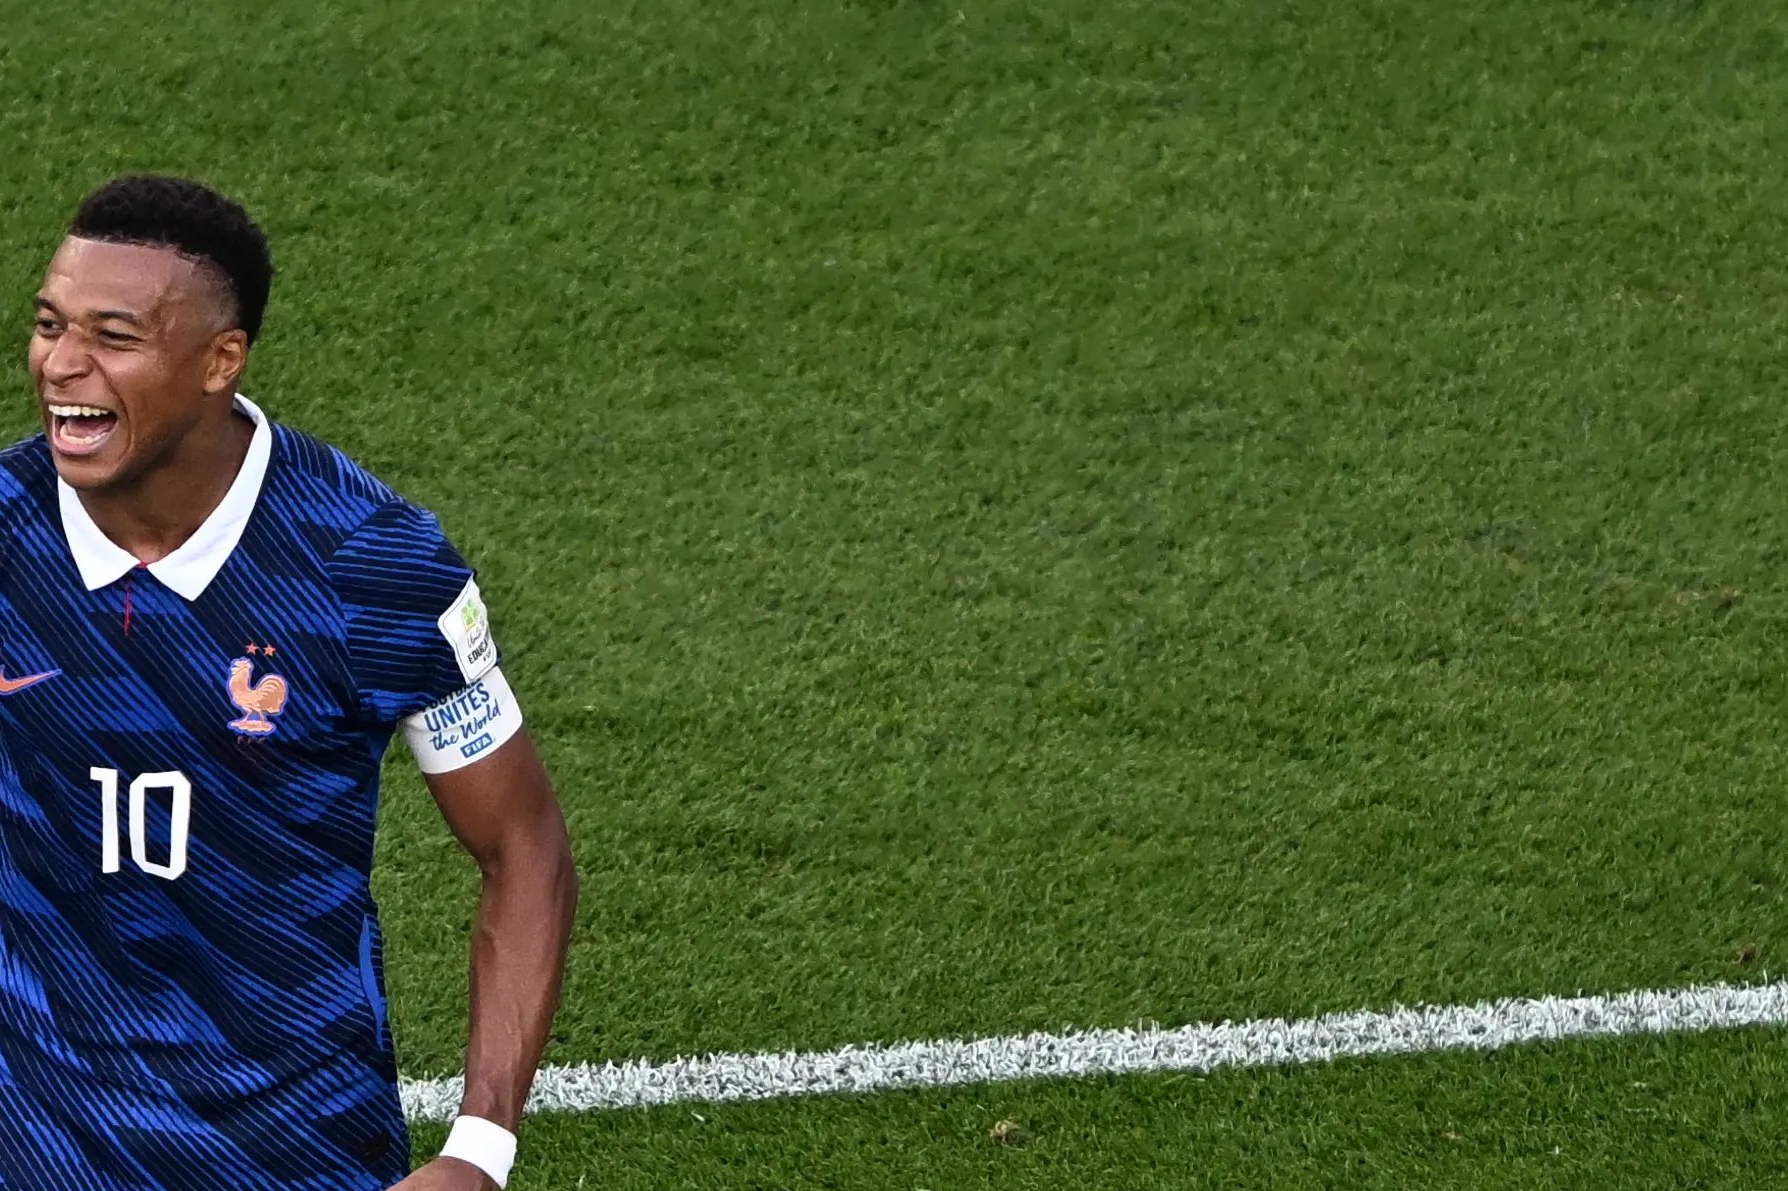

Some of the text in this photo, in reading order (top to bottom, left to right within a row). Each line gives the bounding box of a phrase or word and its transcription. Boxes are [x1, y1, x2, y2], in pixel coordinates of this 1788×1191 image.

[424, 678, 482, 711] OOTB
[424, 682, 490, 732] UNITES
[428, 697, 502, 752] the World
[462, 734, 492, 757] FIFA
[90, 766, 191, 880] 10
